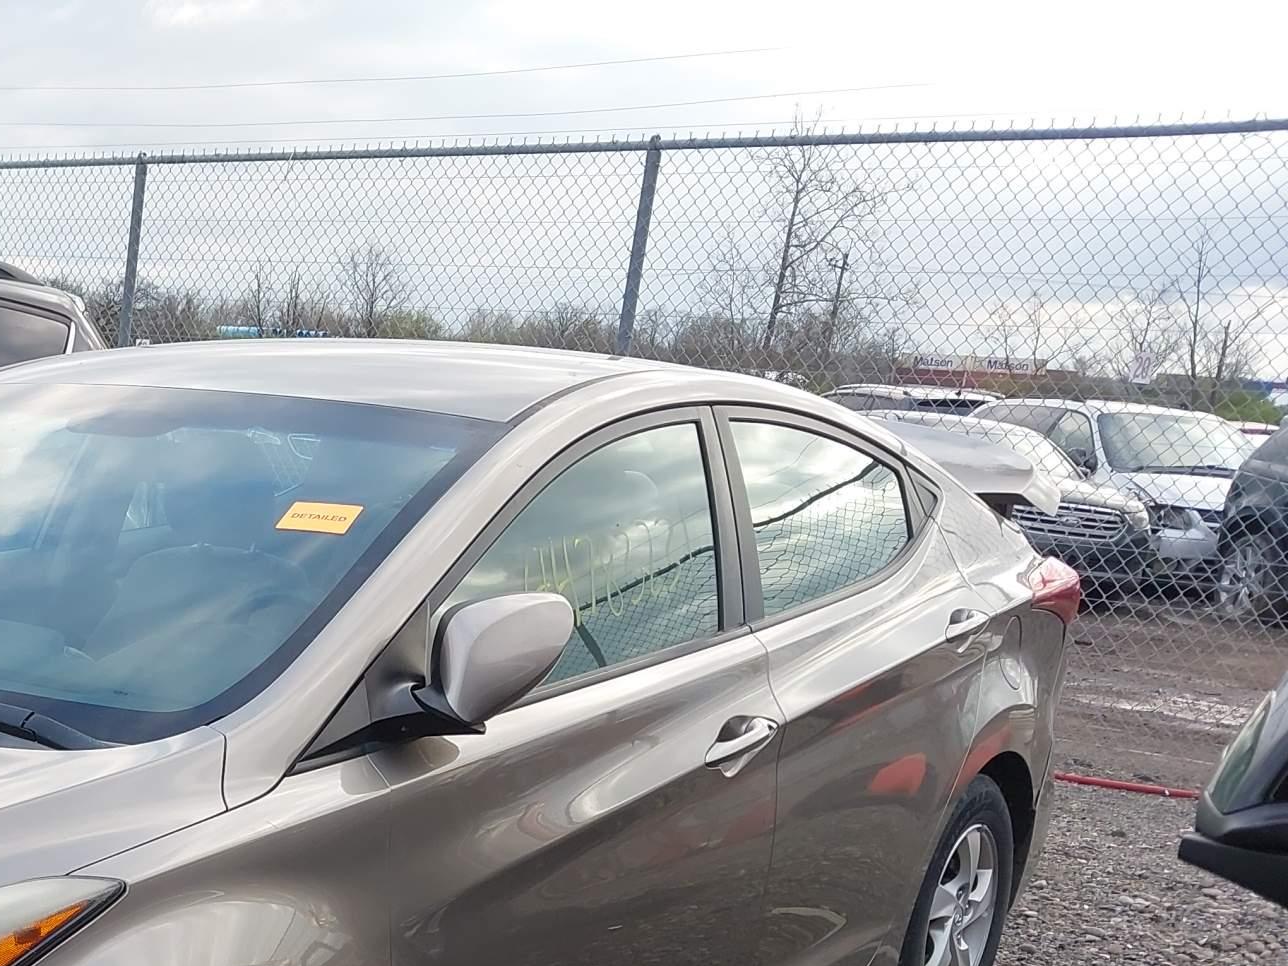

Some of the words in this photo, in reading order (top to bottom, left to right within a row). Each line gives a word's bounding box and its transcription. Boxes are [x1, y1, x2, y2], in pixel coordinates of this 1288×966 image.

[913, 356, 953, 368] Matson
[986, 359, 1029, 371] Matson
[292, 512, 347, 522] DETAILED
